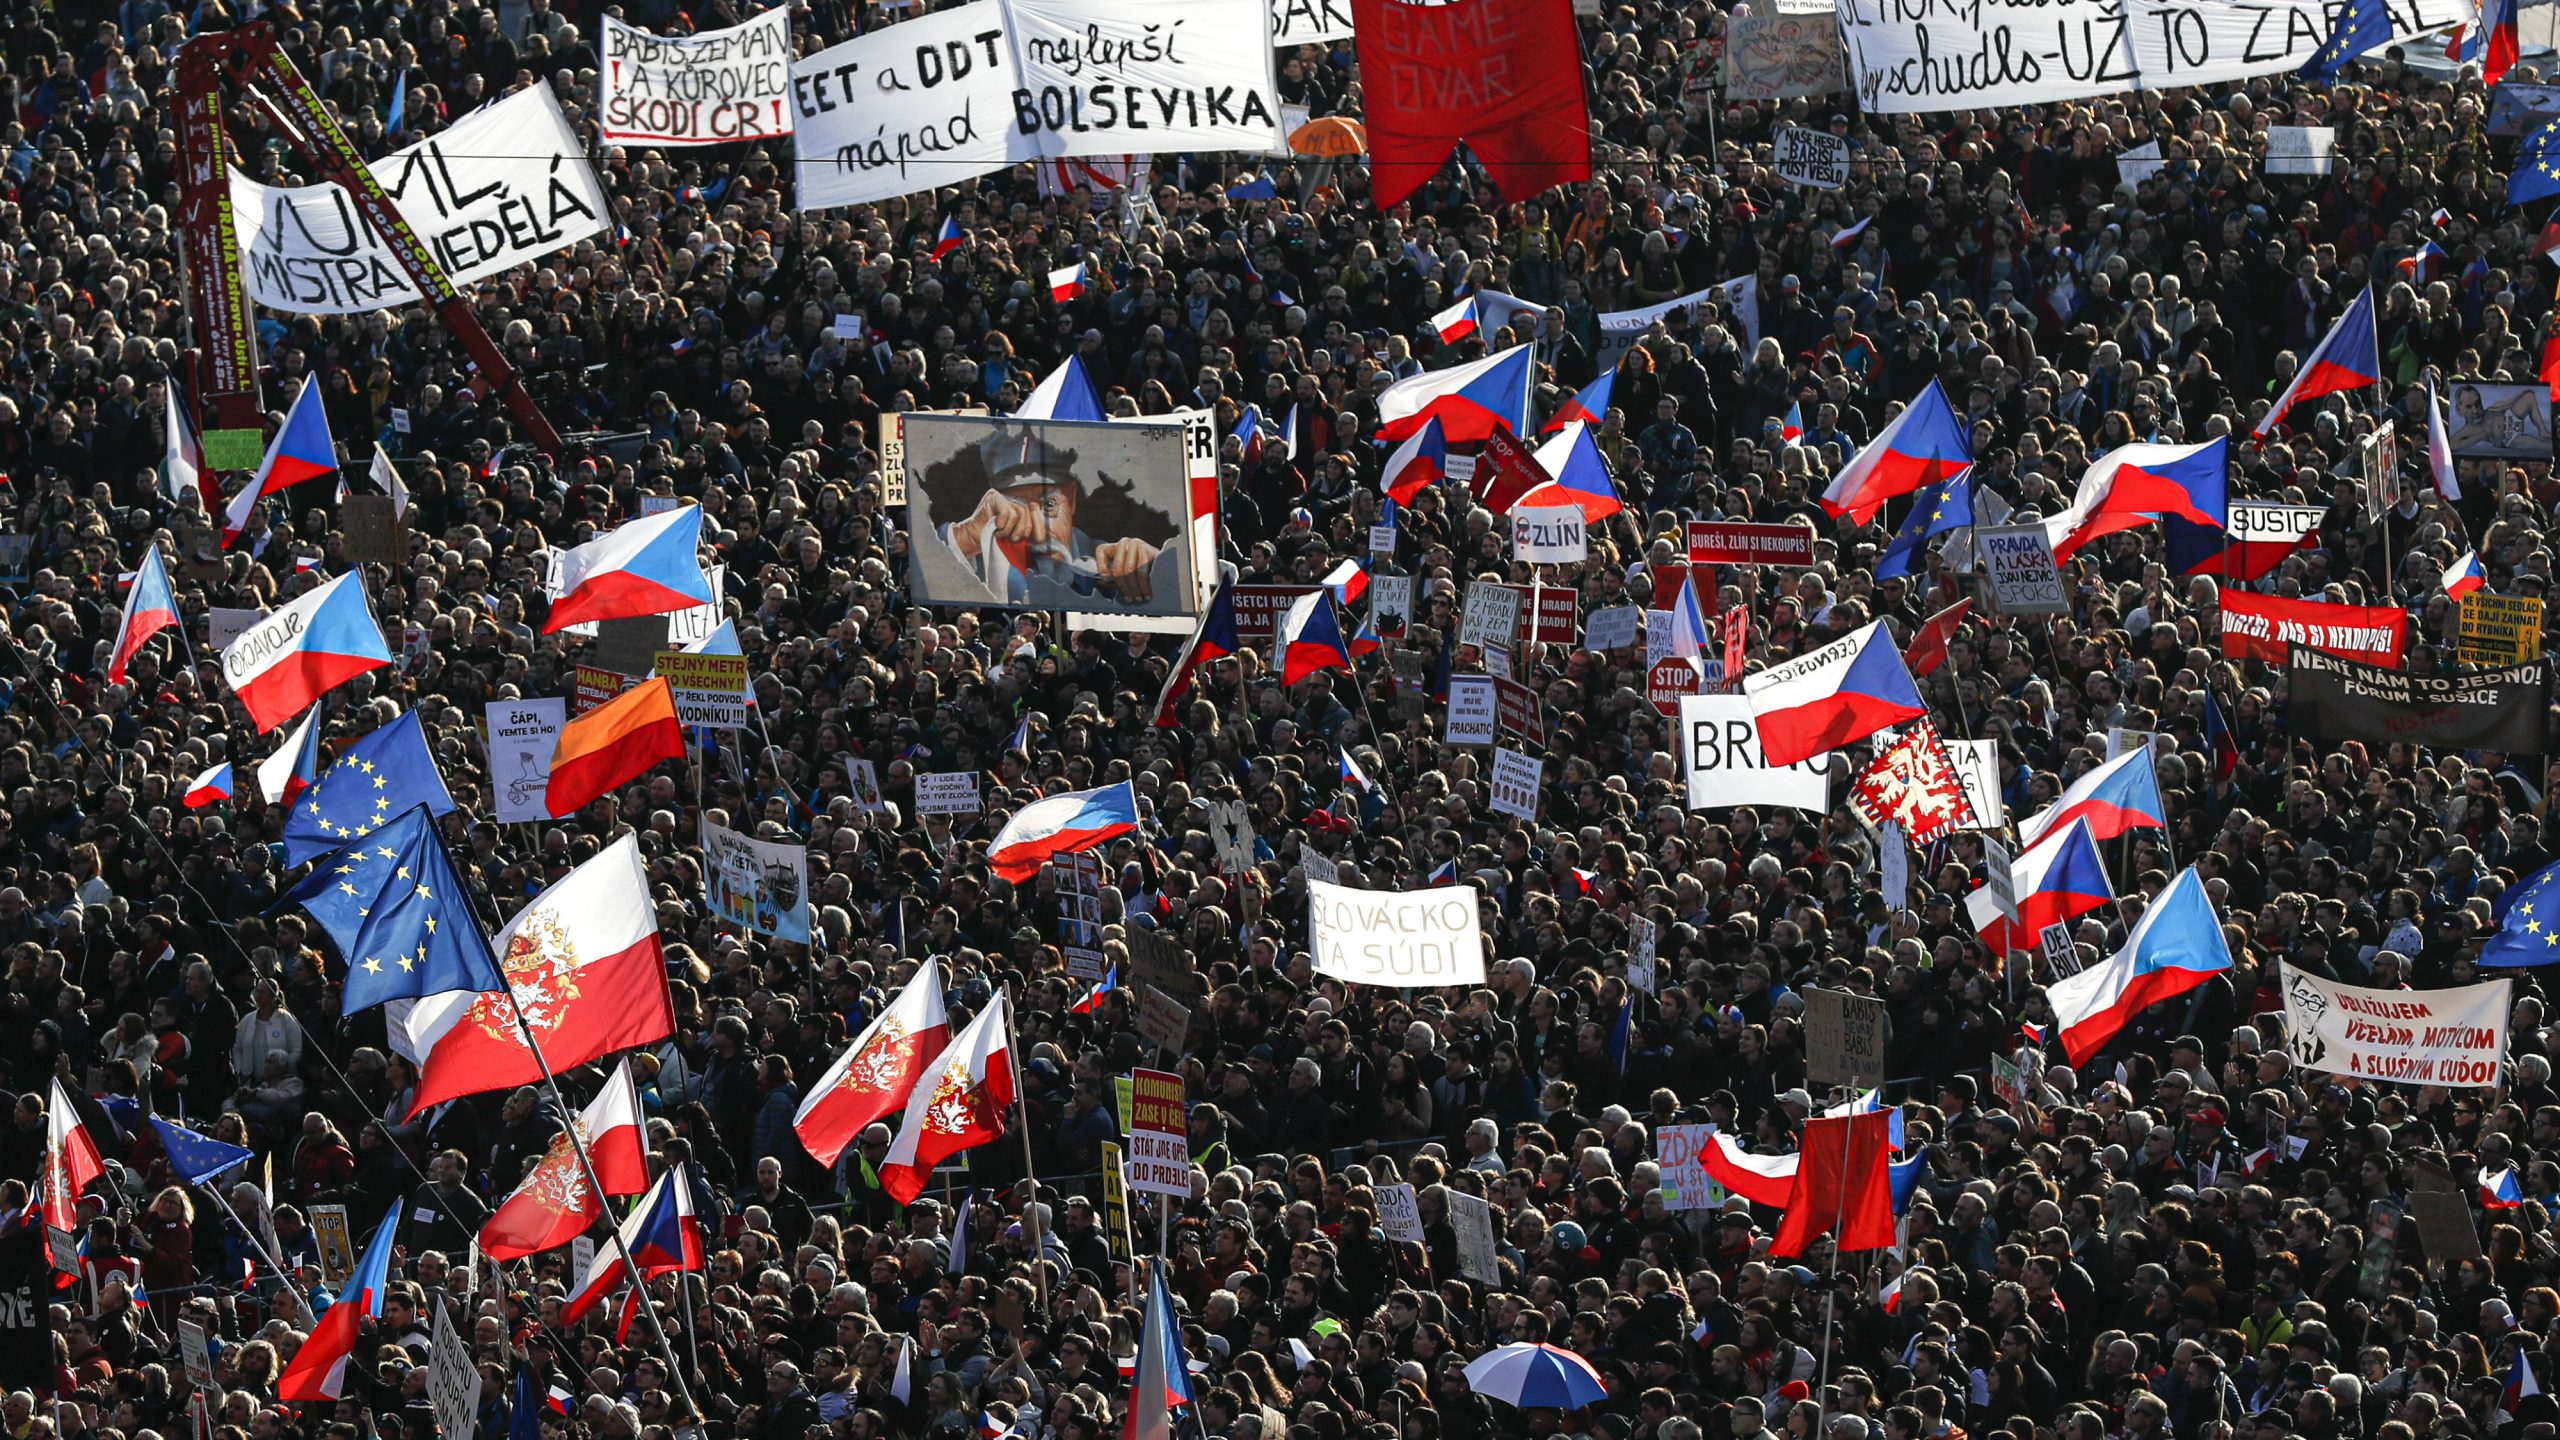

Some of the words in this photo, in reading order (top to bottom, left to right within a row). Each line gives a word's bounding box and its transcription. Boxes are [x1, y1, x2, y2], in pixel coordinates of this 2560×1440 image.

[1029, 19, 1185, 76] nejlepší
[2149, 8, 2208, 73] TO
[629, 61, 652, 97] A
[663, 63, 788, 101] KŮROVEC
[793, 63, 858, 118] EET
[876, 67, 911, 92] a
[1012, 76, 1275, 135] BOLŠEVIKA
[837, 96, 978, 180] nápad
[1809, 164, 1843, 185] VESLO
[216, 199, 237, 263] PRAHA
[365, 199, 395, 236] 602
[392, 237, 422, 273] 205
[417, 271, 445, 305] 951
[251, 249, 411, 307] MISTRA
[225, 271, 244, 329] Ostrava
[1491, 434, 1514, 457] STOP
[1532, 518, 1581, 547] ZLÍN
[1691, 532, 1732, 553] BUREŠI,
[1729, 533, 1749, 551] ZLÍN
[1750, 536, 1760, 551] SI
[1761, 533, 1806, 553] NEKOUPÍŠ
[1990, 537, 2040, 554] PRAVDA
[1995, 558, 2005, 571] A
[1999, 570, 2020, 585] JSOU
[1470, 584, 1482, 599] ZA
[1997, 585, 2060, 604] SPOKO
[1471, 600, 1479, 613] Z
[1482, 601, 1515, 620] HRADU
[1542, 600, 1573, 612] HRADU
[2464, 595, 2475, 606] NE
[2475, 596, 2506, 610] VŠICHNI
[2461, 622, 2474, 633] DO
[2463, 609, 2475, 620] SE
[2501, 613, 2538, 626] ZAHNAT
[2277, 619, 2306, 644] NÁS
[2308, 625, 2325, 647] SI
[657, 654, 706, 671] STEJNÝ
[708, 659, 745, 674] METR
[2293, 650, 2352, 678] NENÍ
[2357, 668, 2411, 690] NÁM
[2415, 678, 2453, 691] TO
[2457, 666, 2543, 690] JEDNO!
[576, 669, 619, 691] HANBA
[683, 672, 735, 688] VŠECHNY
[1656, 667, 1694, 687] STOP
[685, 691, 706, 703] ŘEKL
[707, 693, 745, 705] PODVOD.
[2344, 679, 2411, 703] FÓRUM
[2428, 689, 2499, 706] SUŠICE
[510, 710, 542, 726] ČÁPI,
[678, 704, 730, 724] VODNÍKU
[498, 725, 528, 737] VEMTE
[530, 725, 538, 735] SI
[540, 724, 556, 735] HO!
[1450, 722, 1493, 736] PRACHATIC
[1694, 720, 1830, 775] BR
[930, 783, 966, 791] VYSOČINY
[916, 805, 948, 813] NEJSME
[1313, 892, 1469, 933] SLOVÁCKO
[2350, 1052, 2361, 1073] A
[2366, 1051, 2435, 1081] SLUŠNÝM
[1135, 1103, 1159, 1123] ZASE
[1134, 1133, 1154, 1157] STÁT
[1133, 1162, 1149, 1181] DO
[1675, 1169, 1684, 1187] U
